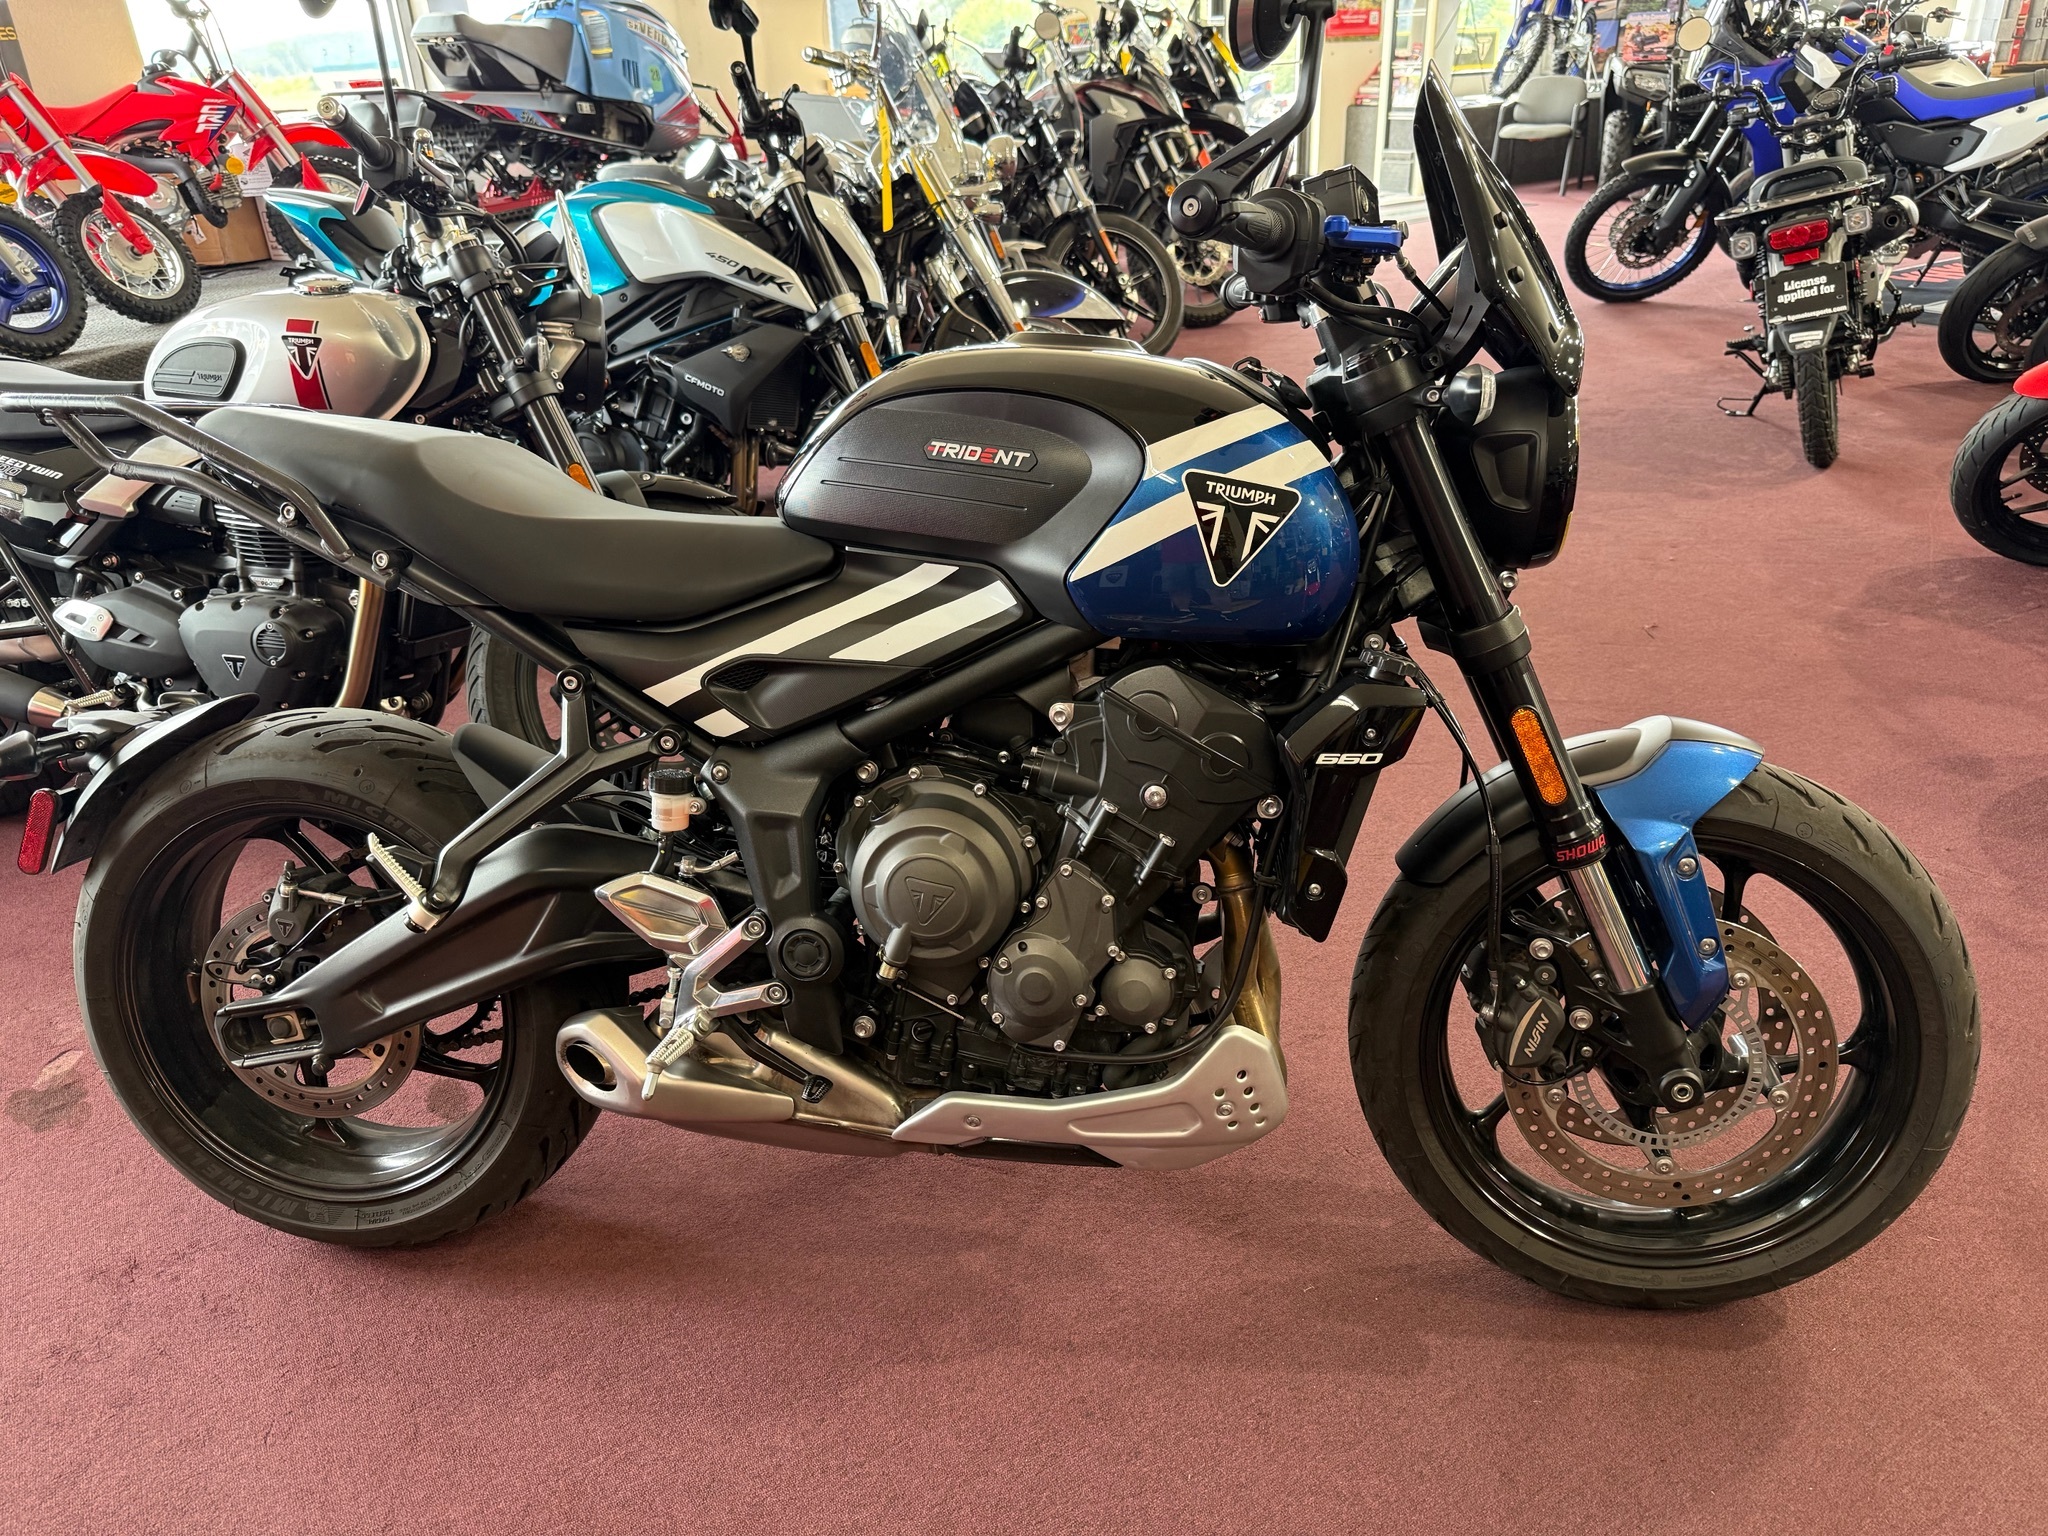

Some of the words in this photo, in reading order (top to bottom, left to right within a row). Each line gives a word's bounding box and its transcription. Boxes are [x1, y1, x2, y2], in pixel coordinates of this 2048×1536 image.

[194, 104, 228, 134] CRF
[705, 251, 740, 268] 450
[728, 265, 794, 294] NK
[1783, 275, 1828, 292] License
[1777, 286, 1819, 304] applied
[1819, 284, 1836, 295] for
[288, 337, 315, 347] TRIUMPH
[684, 373, 725, 397] CFMOTO
[928, 441, 1031, 467] TRIDENT
[26, 463, 64, 480] TWIN
[1206, 481, 1277, 506] TRIUMPH
[1315, 753, 1384, 765] 660
[1556, 833, 1607, 862] SHOWA
[1524, 1013, 1550, 1058] NISSIN
